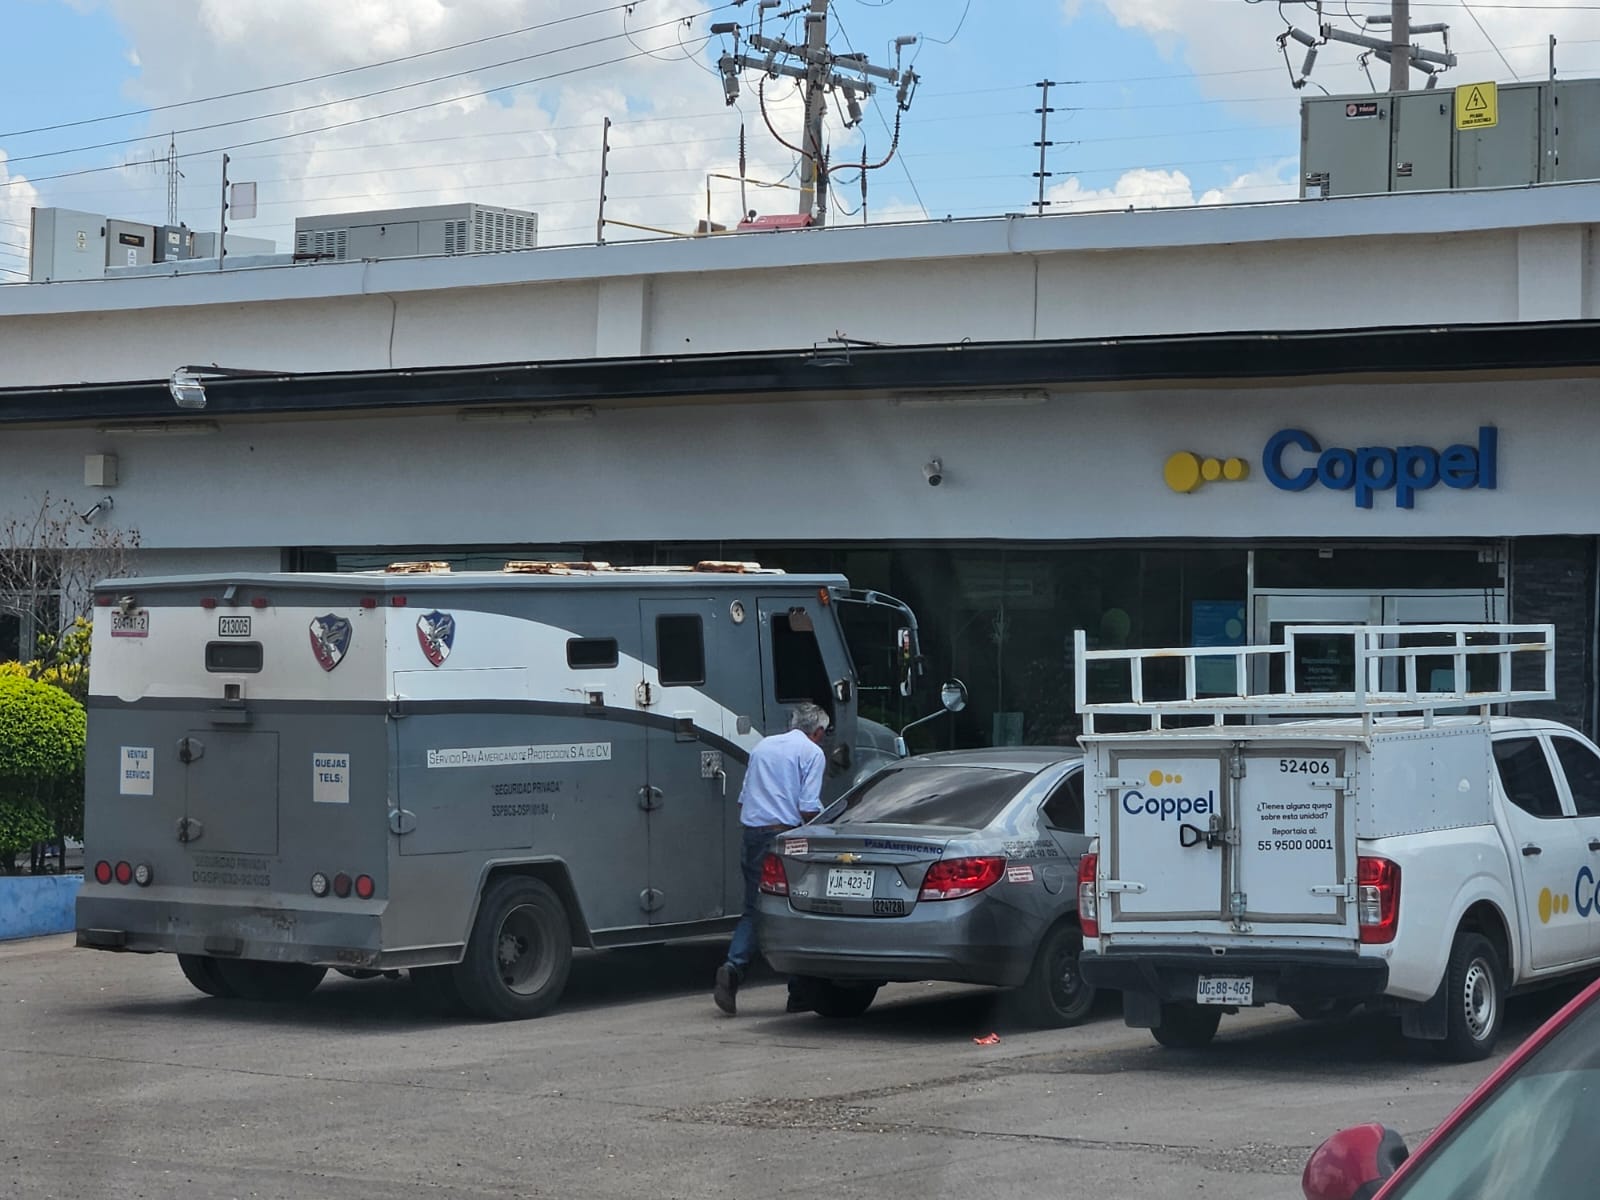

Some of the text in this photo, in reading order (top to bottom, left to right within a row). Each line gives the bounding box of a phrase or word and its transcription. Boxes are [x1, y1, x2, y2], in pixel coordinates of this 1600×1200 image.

[1262, 426, 1498, 510] Coppel
[127, 750, 148, 759] VENTAS
[135, 760, 140, 769] Y
[315, 759, 347, 768] QUEJAS
[1279, 759, 1330, 774] 52406
[319, 773, 343, 783] TELS:
[1123, 790, 1214, 821] Coppel
[1286, 802, 1311, 811] alguna
[1260, 813, 1281, 821] sobre
[1258, 839, 1333, 851] 55 9500 0001
[1575, 866, 1600, 918] C
[1199, 981, 1251, 995] UG-88-465
